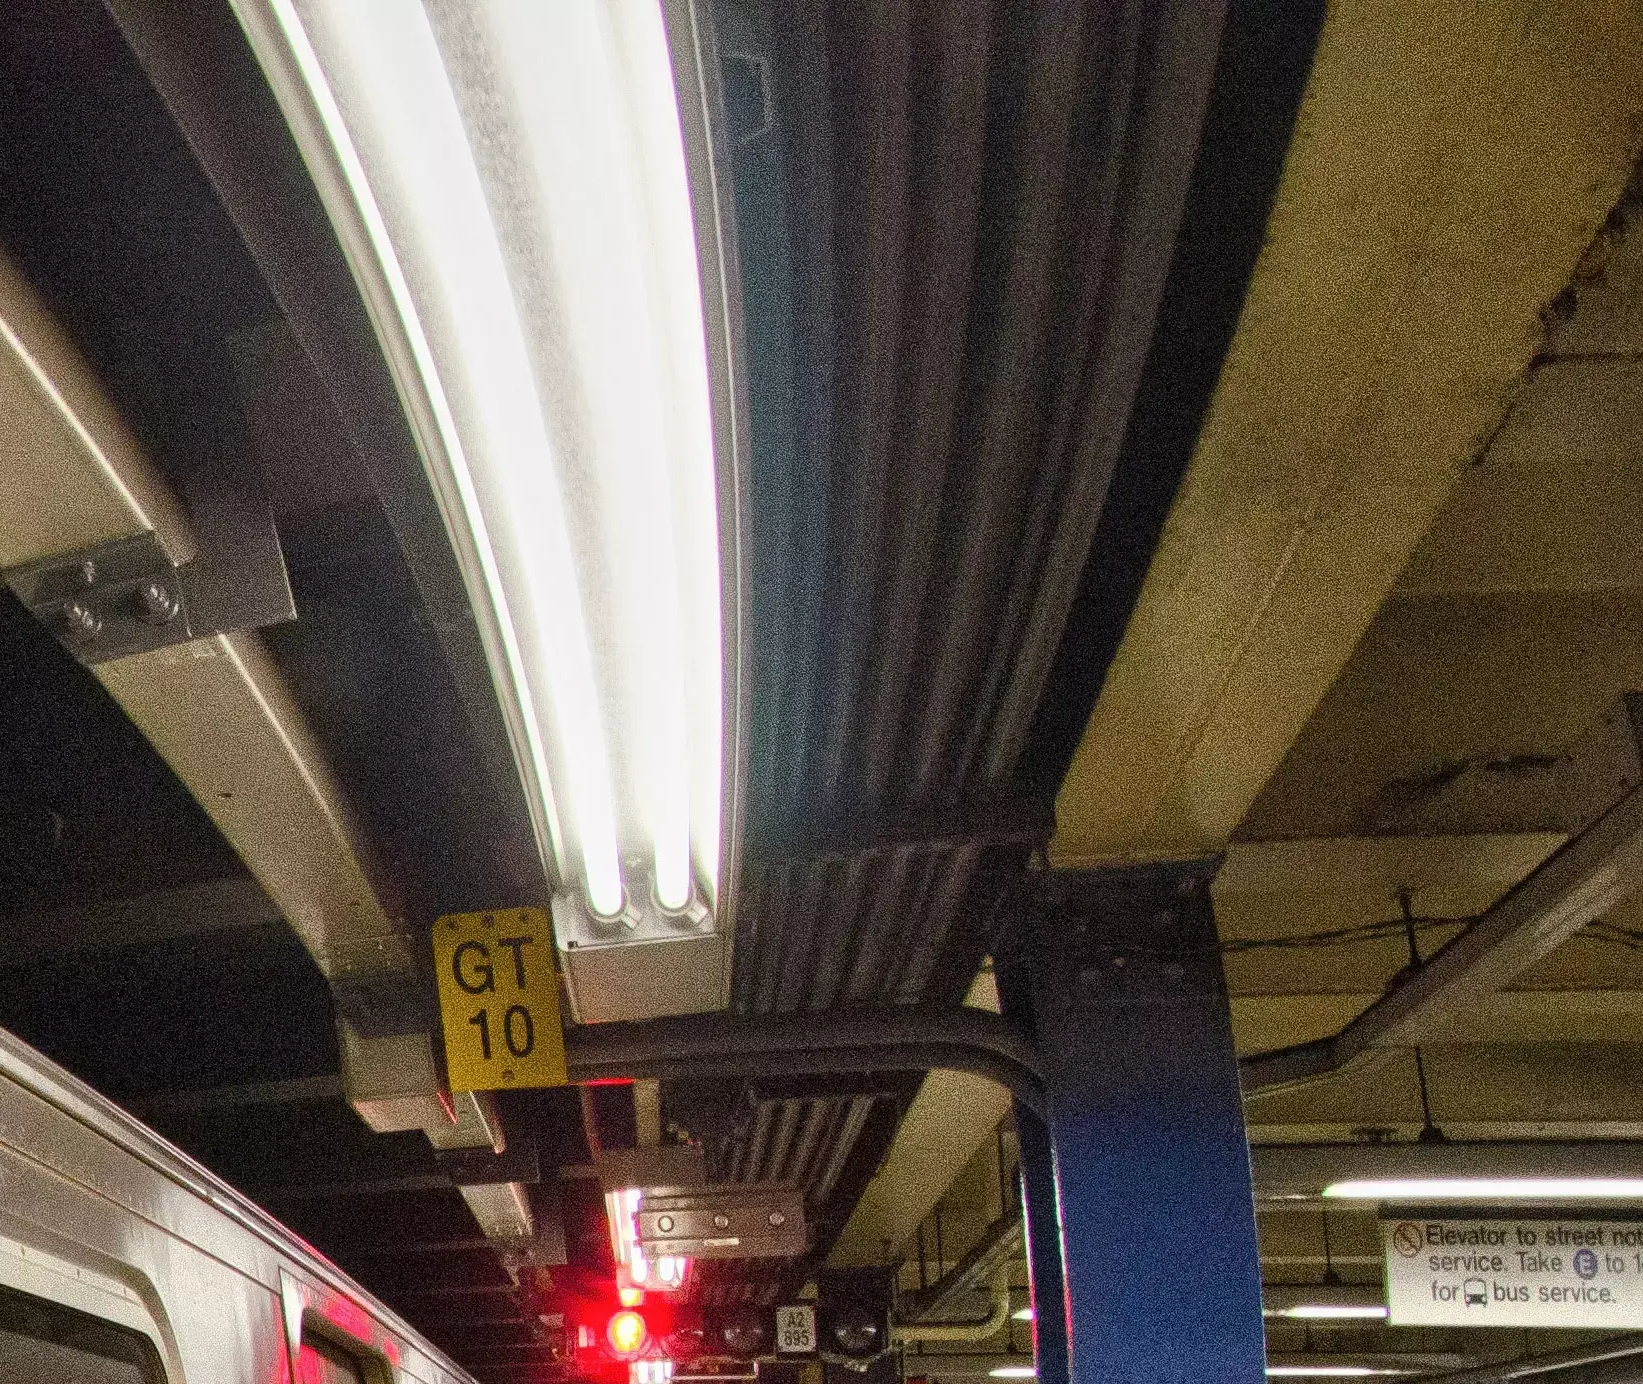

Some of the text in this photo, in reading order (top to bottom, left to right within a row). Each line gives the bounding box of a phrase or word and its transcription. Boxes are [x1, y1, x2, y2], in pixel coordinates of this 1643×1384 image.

[452, 936, 533, 995] GT
[469, 1004, 534, 1060] 10
[1426, 1224, 1508, 1246] Elevator
[1516, 1227, 1537, 1246] to
[1545, 1226, 1604, 1246] street
[1429, 1251, 1508, 1273] service.
[1518, 1251, 1563, 1273] Take
[1605, 1253, 1625, 1273] to
[1432, 1280, 1616, 1303] for bus service.
[787, 1311, 804, 1328] A2
[784, 1330, 809, 1346] 895
